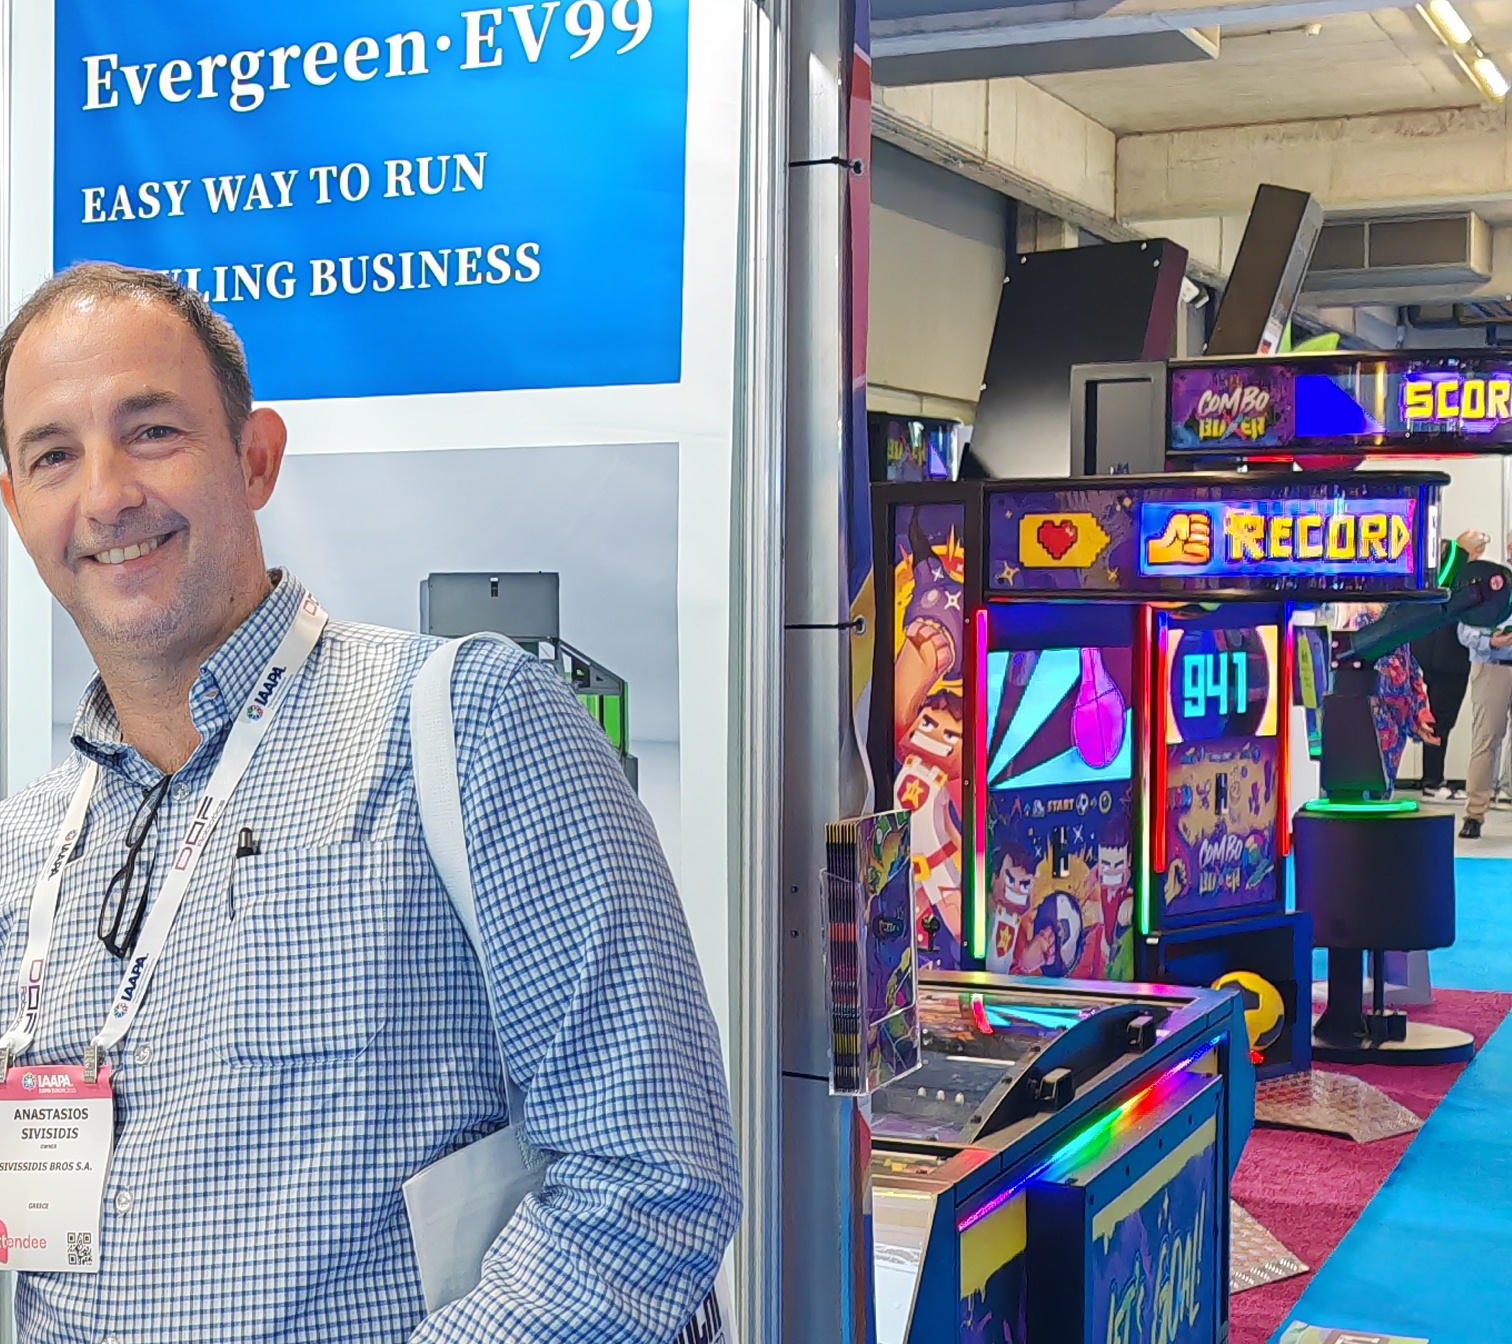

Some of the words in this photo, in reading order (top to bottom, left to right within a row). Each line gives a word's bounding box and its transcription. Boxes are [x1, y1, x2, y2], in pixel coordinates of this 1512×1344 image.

[81, 179, 191, 224] EASY
[202, 169, 299, 215] WAY
[309, 162, 370, 203] TO
[383, 151, 487, 198] RUN
[152, 261, 297, 303] LING
[311, 241, 541, 297] BUSINESS
[1198, 386, 1270, 417] COMBO
[1226, 508, 1411, 562] RECORD
[254, 666, 287, 706] IAAPA
[1184, 651, 1248, 717] 941
[1047, 798, 1075, 812] START
[1199, 834, 1242, 869] COMBO
[121, 953, 149, 1001] IAAPA
[38, 1074, 73, 1087] IAAPA
[14, 1108, 89, 1120] ANASTASIOS
[21, 1127, 79, 1140] SIVISIDIS
[49, 1162, 74, 1171] BROS
[75, 1161, 93, 1171] S.A.
